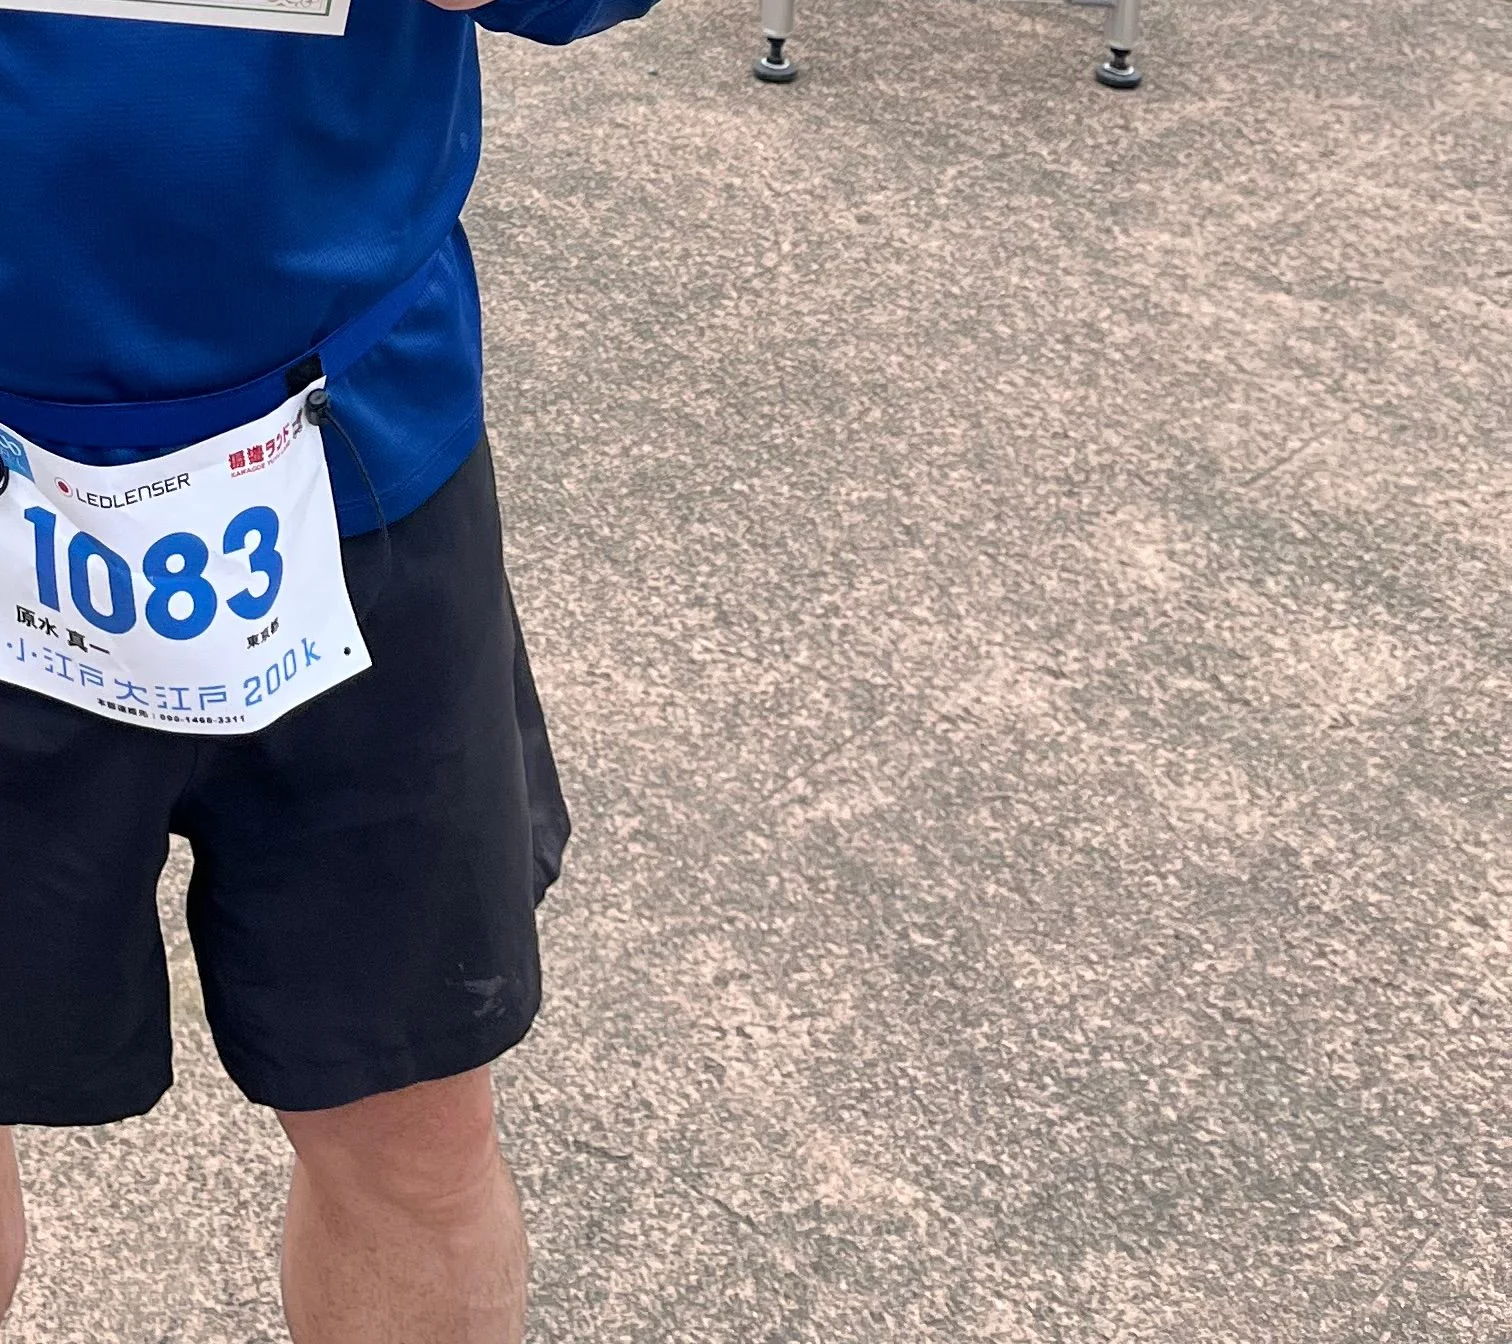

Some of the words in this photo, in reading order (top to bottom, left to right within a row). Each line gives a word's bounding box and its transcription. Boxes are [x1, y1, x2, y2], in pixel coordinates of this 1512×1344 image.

[75, 472, 192, 510] LEDLENSER
[23, 505, 284, 641] 1083
[15, 604, 59, 639] 原水
[65, 628, 111, 656] 真一
[6, 637, 228, 712] 小江戸大江戸
